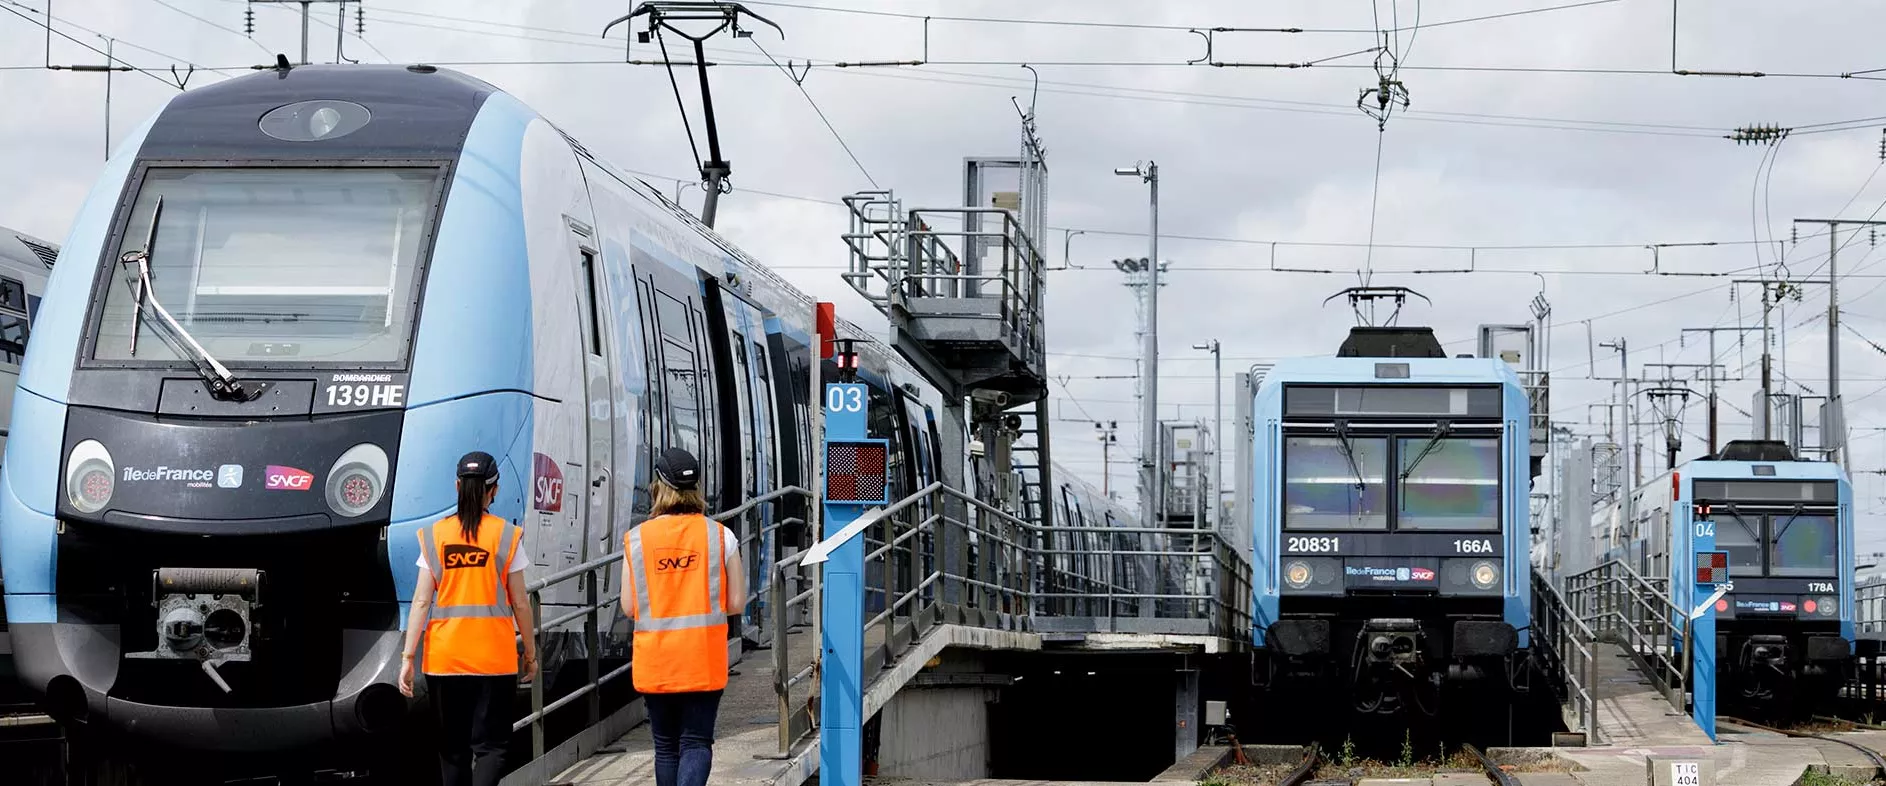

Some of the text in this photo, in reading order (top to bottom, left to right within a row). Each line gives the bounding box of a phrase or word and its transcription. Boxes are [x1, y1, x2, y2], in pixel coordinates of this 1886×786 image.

[333, 374, 392, 382] BOMBARDIER
[829, 387, 862, 412] 03
[267, 475, 310, 487] SNCF
[536, 476, 562, 504] SNCF
[1696, 524, 1714, 537] 04
[1288, 538, 1339, 551] 20831
[1454, 540, 1493, 553] 166A
[447, 552, 487, 566] SNCF
[657, 555, 697, 570] SNCF
[1411, 572, 1433, 580] SNCF
[1808, 583, 1834, 592] 178A
[1677, 776, 1698, 785] 404
